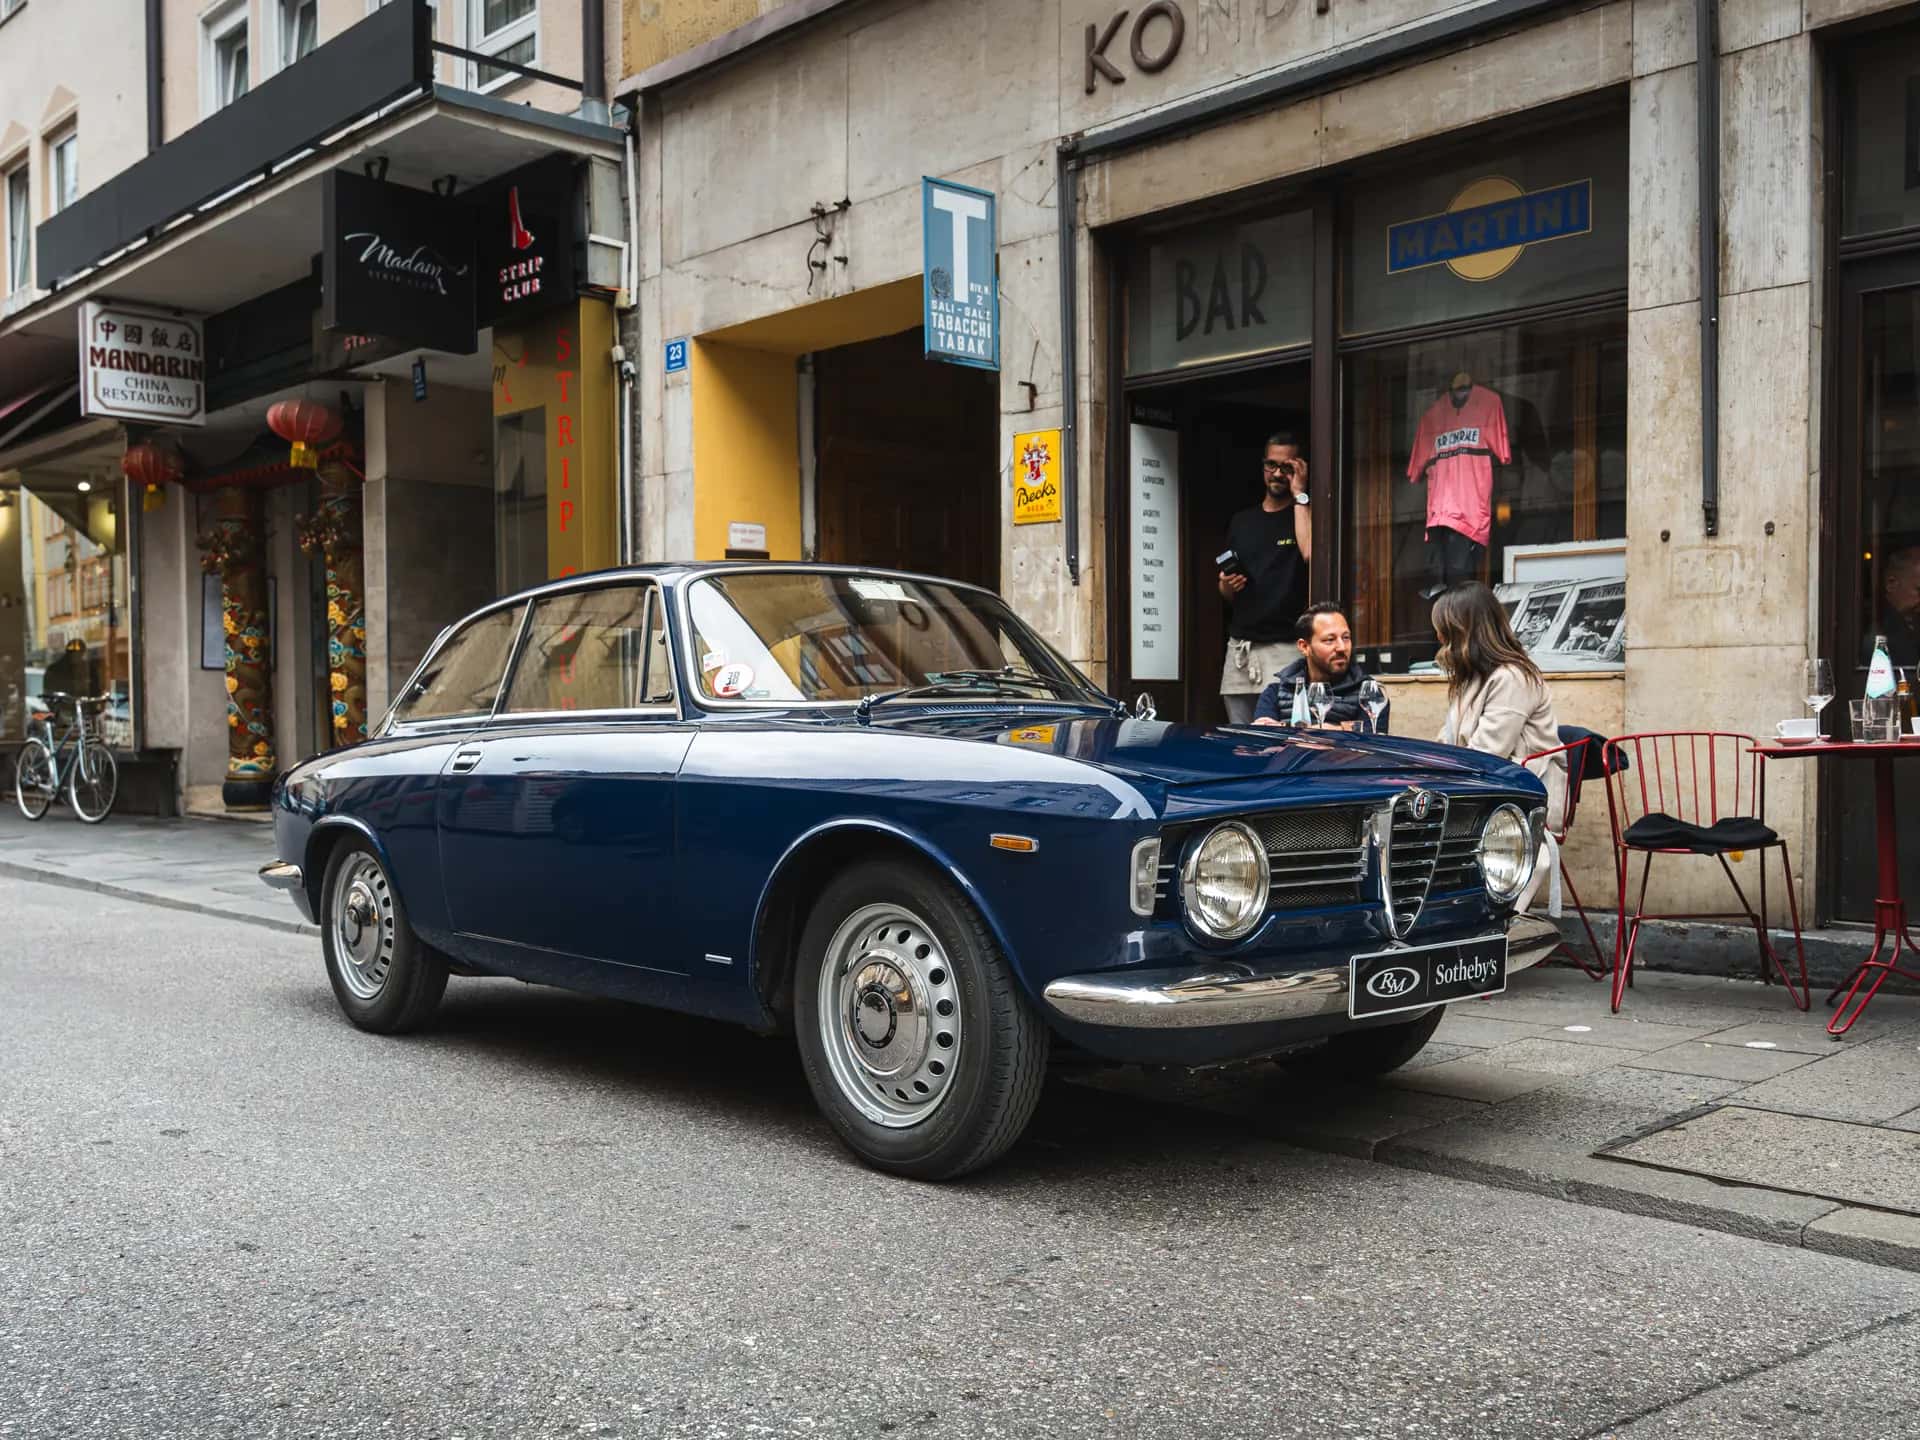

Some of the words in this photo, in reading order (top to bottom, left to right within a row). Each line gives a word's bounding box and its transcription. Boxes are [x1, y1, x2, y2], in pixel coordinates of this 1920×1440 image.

[1396, 191, 1581, 264] MARTINI
[933, 188, 986, 304] T
[344, 232, 450, 295] Madam
[499, 256, 544, 284] STRIP
[503, 277, 541, 301] CLUB
[1176, 242, 1268, 342] BAR
[931, 311, 991, 339] TABACCHI
[669, 344, 682, 361] 23
[938, 331, 985, 356] TABAK
[90, 346, 204, 381] MANDARIN
[102, 387, 193, 409] RESTAURANT
[125, 376, 170, 393] CHINA
[1379, 972, 1407, 994] RM
[1435, 956, 1497, 985] Sotheby's
